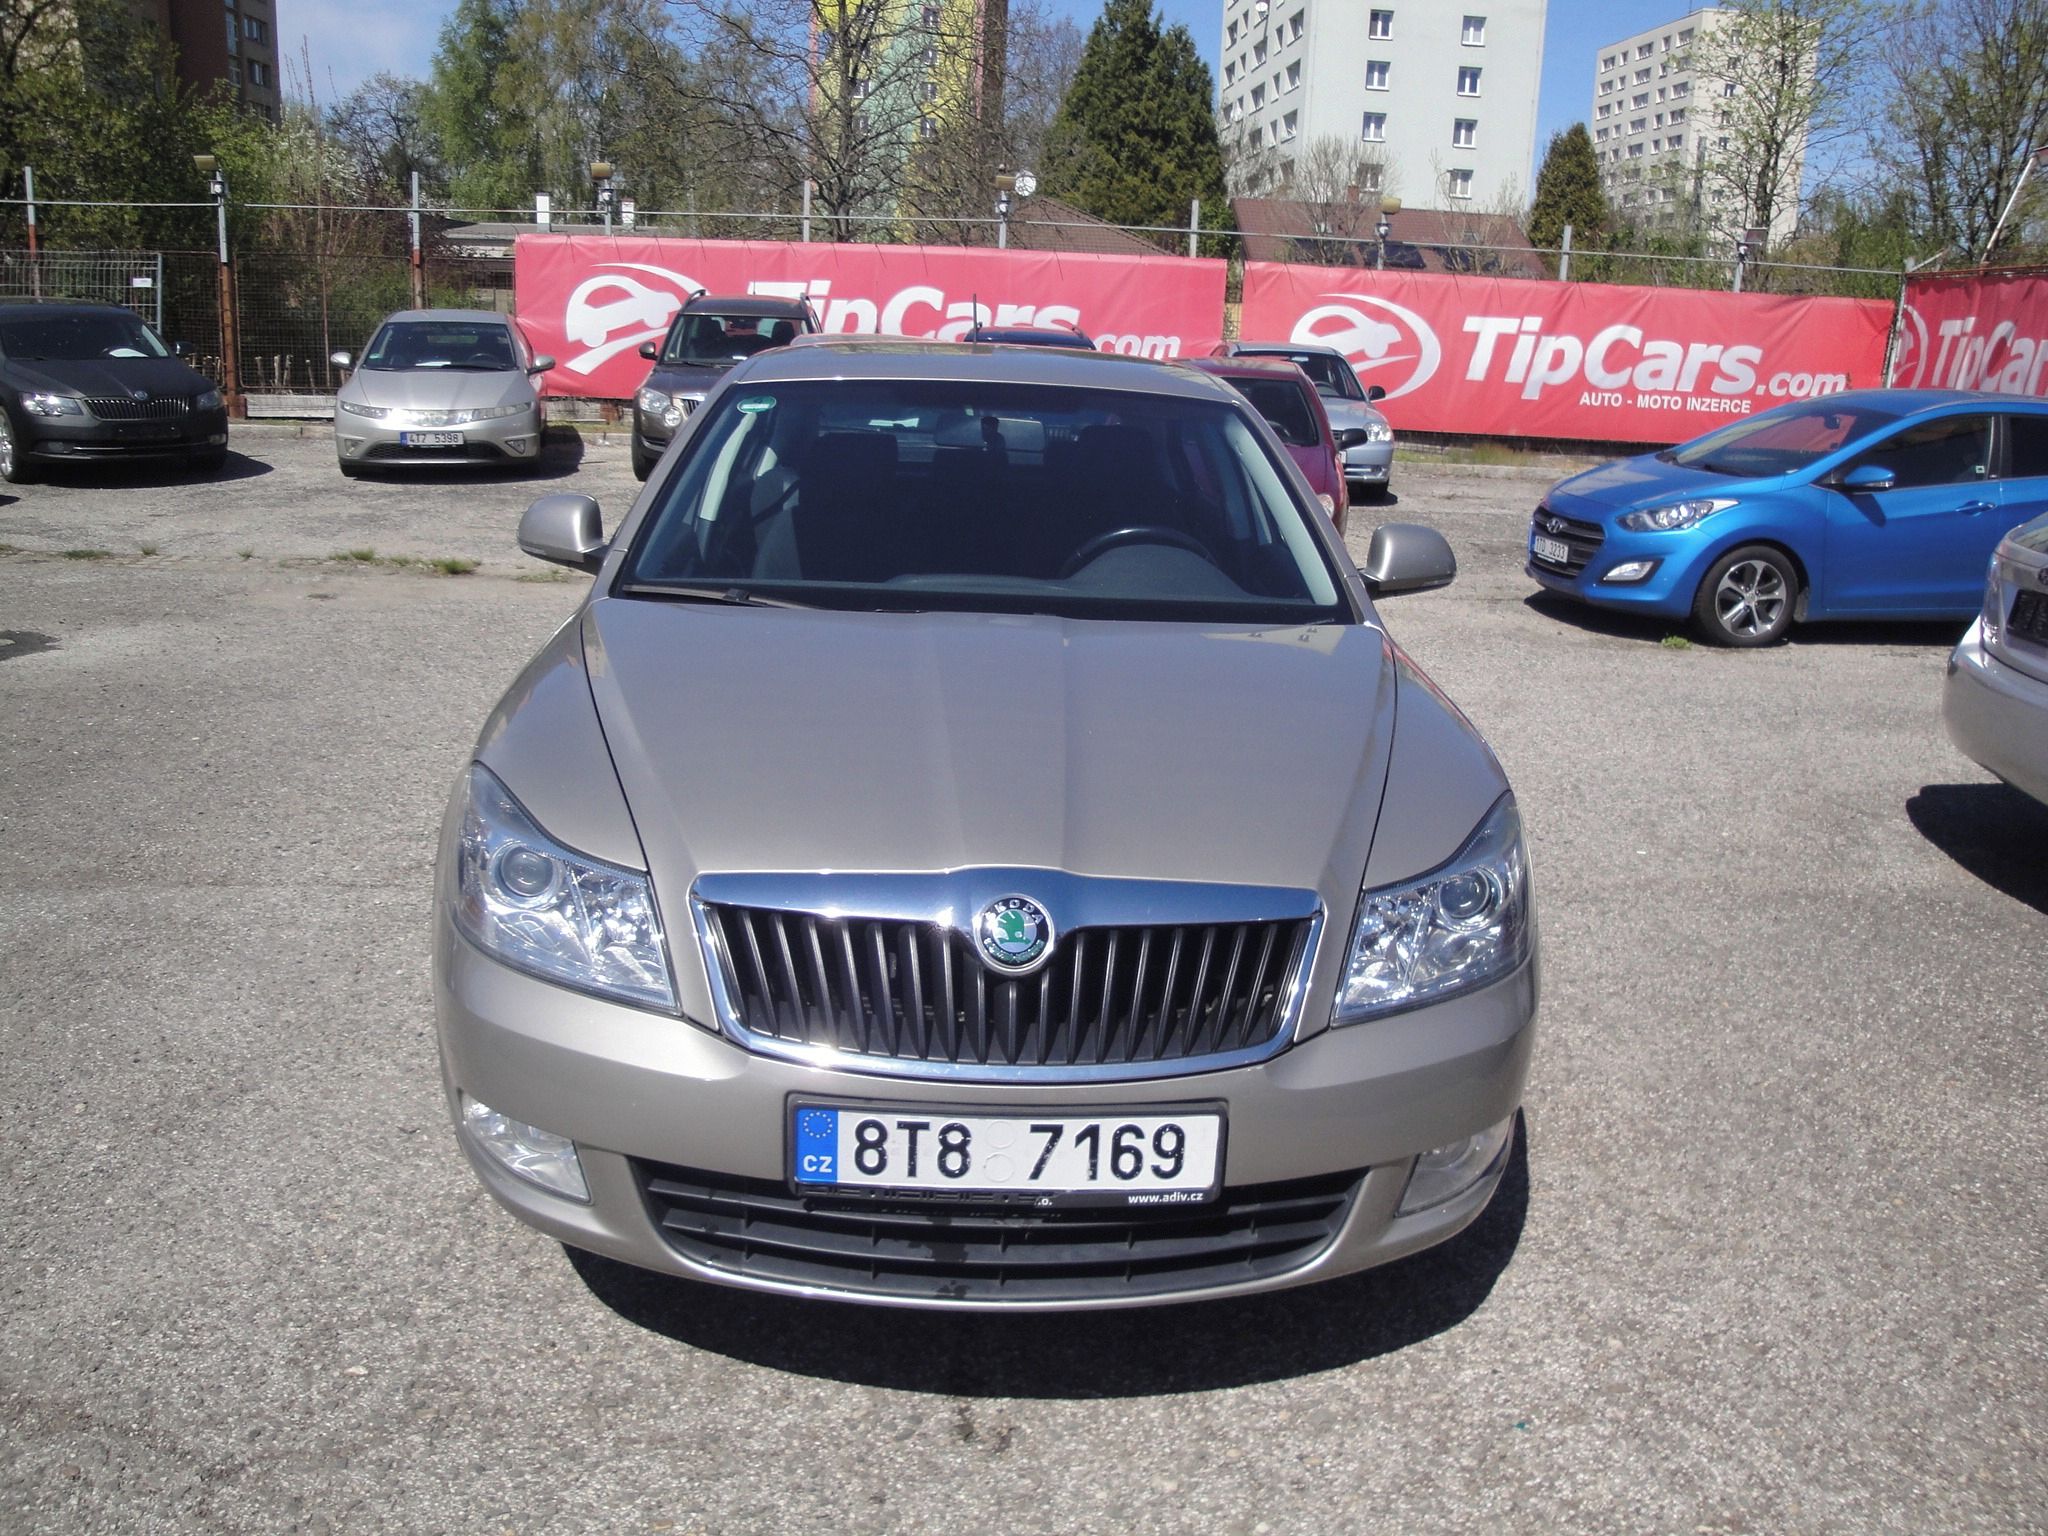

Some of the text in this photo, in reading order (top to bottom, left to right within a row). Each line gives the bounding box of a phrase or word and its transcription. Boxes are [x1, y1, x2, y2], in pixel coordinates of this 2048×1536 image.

[1462, 315, 1846, 401] TipCars.com
[1579, 391, 1622, 408] AUTO
[1636, 395, 1682, 411] MOTO
[1686, 396, 1752, 414] INZERCE
[854, 1118, 1186, 1181] 8T8 7169
[802, 1155, 833, 1174] CZ
[1128, 1191, 1204, 1204] www.adiv.cz
